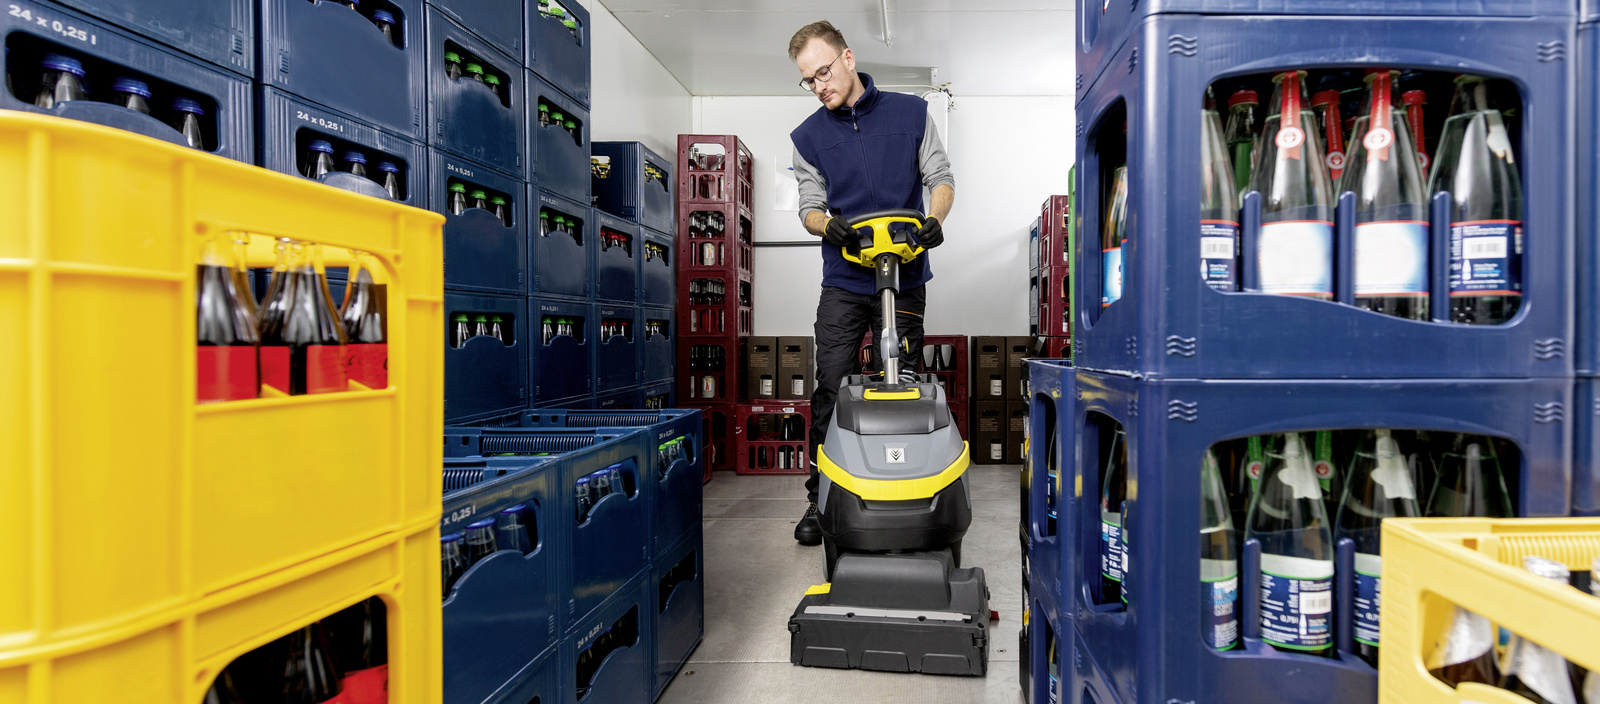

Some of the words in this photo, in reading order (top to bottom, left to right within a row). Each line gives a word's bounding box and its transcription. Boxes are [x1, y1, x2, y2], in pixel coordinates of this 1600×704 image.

[8, 4, 32, 21] 24
[36, 16, 48, 28] x
[51, 20, 87, 41] 0,25
[297, 111, 309, 121] 24
[319, 118, 338, 130] 0,25
[447, 163, 454, 171] 24
[459, 168, 470, 177] 0,25
[443, 517, 450, 526] x
[451, 507, 471, 522] 0,25
[577, 637, 584, 649] 24
